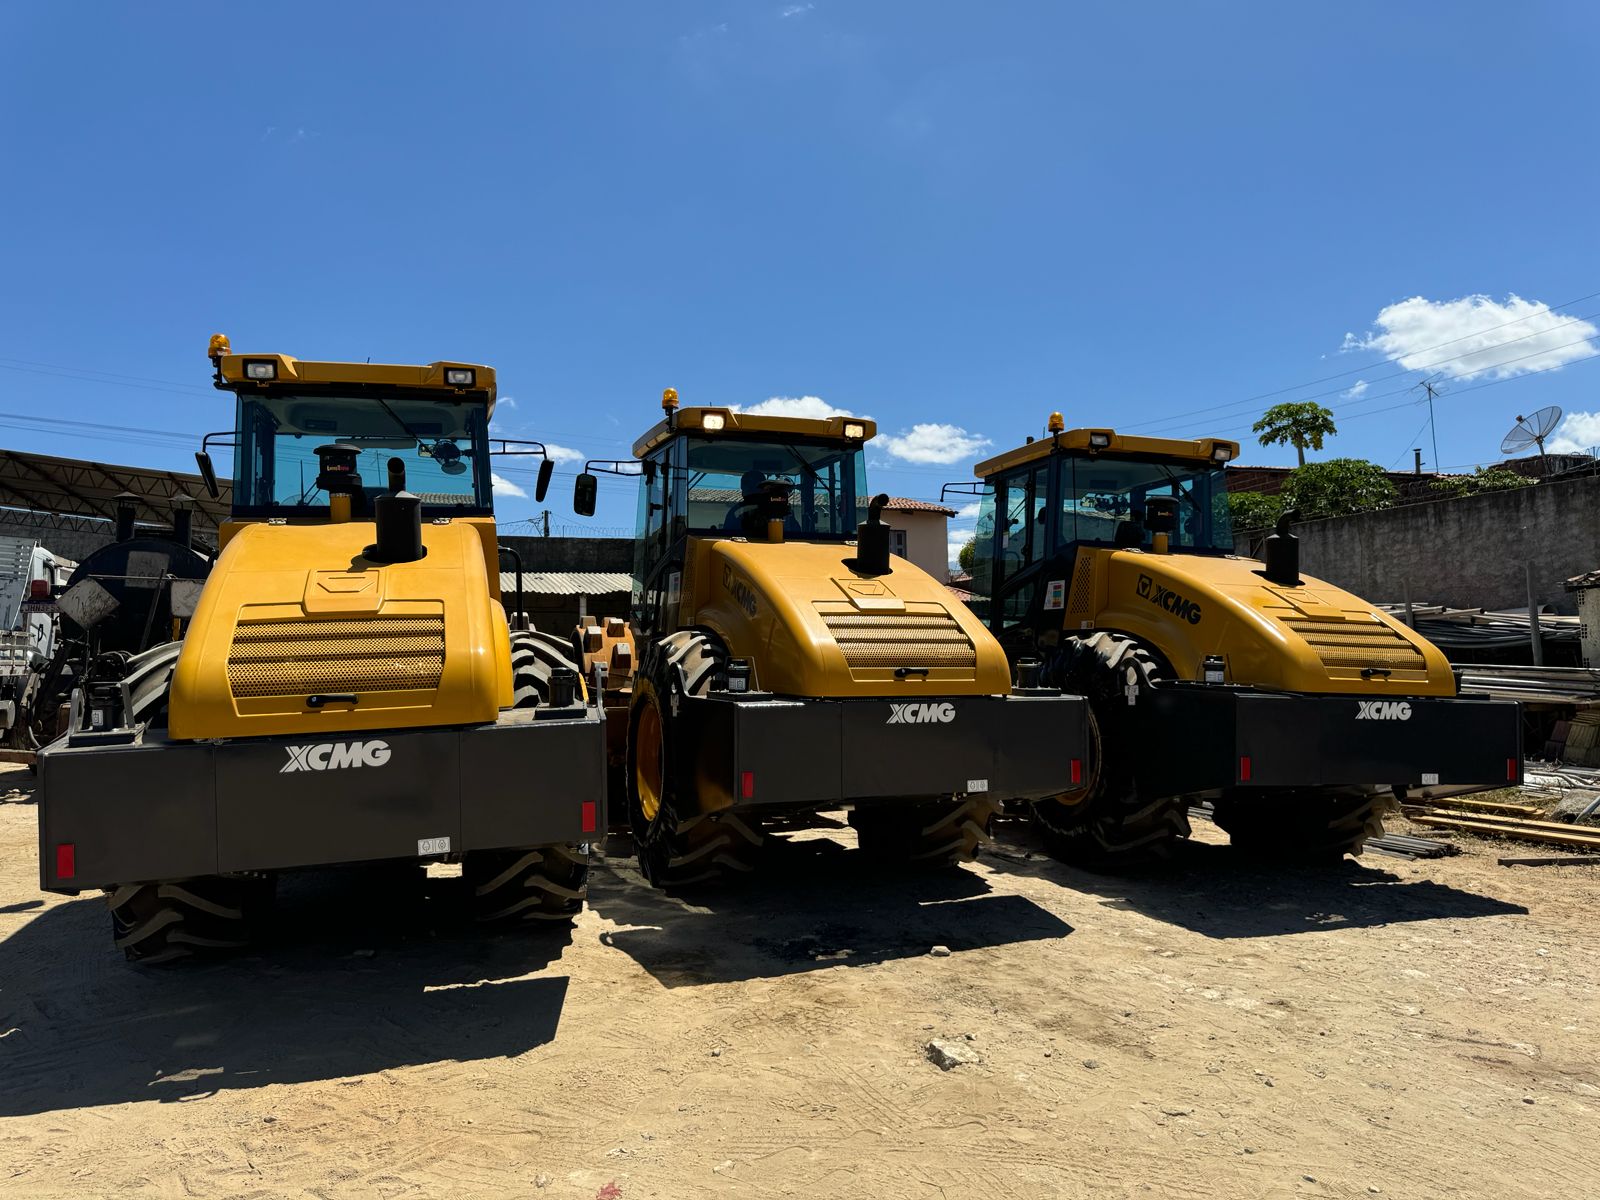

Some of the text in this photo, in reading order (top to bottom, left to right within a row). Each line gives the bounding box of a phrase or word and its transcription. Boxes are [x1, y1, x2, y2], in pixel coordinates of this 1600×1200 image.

[1150, 583, 1202, 625] XCMG
[886, 702, 956, 724] XCMG
[1355, 701, 1412, 721] XCMG
[279, 740, 392, 773] XCMG
